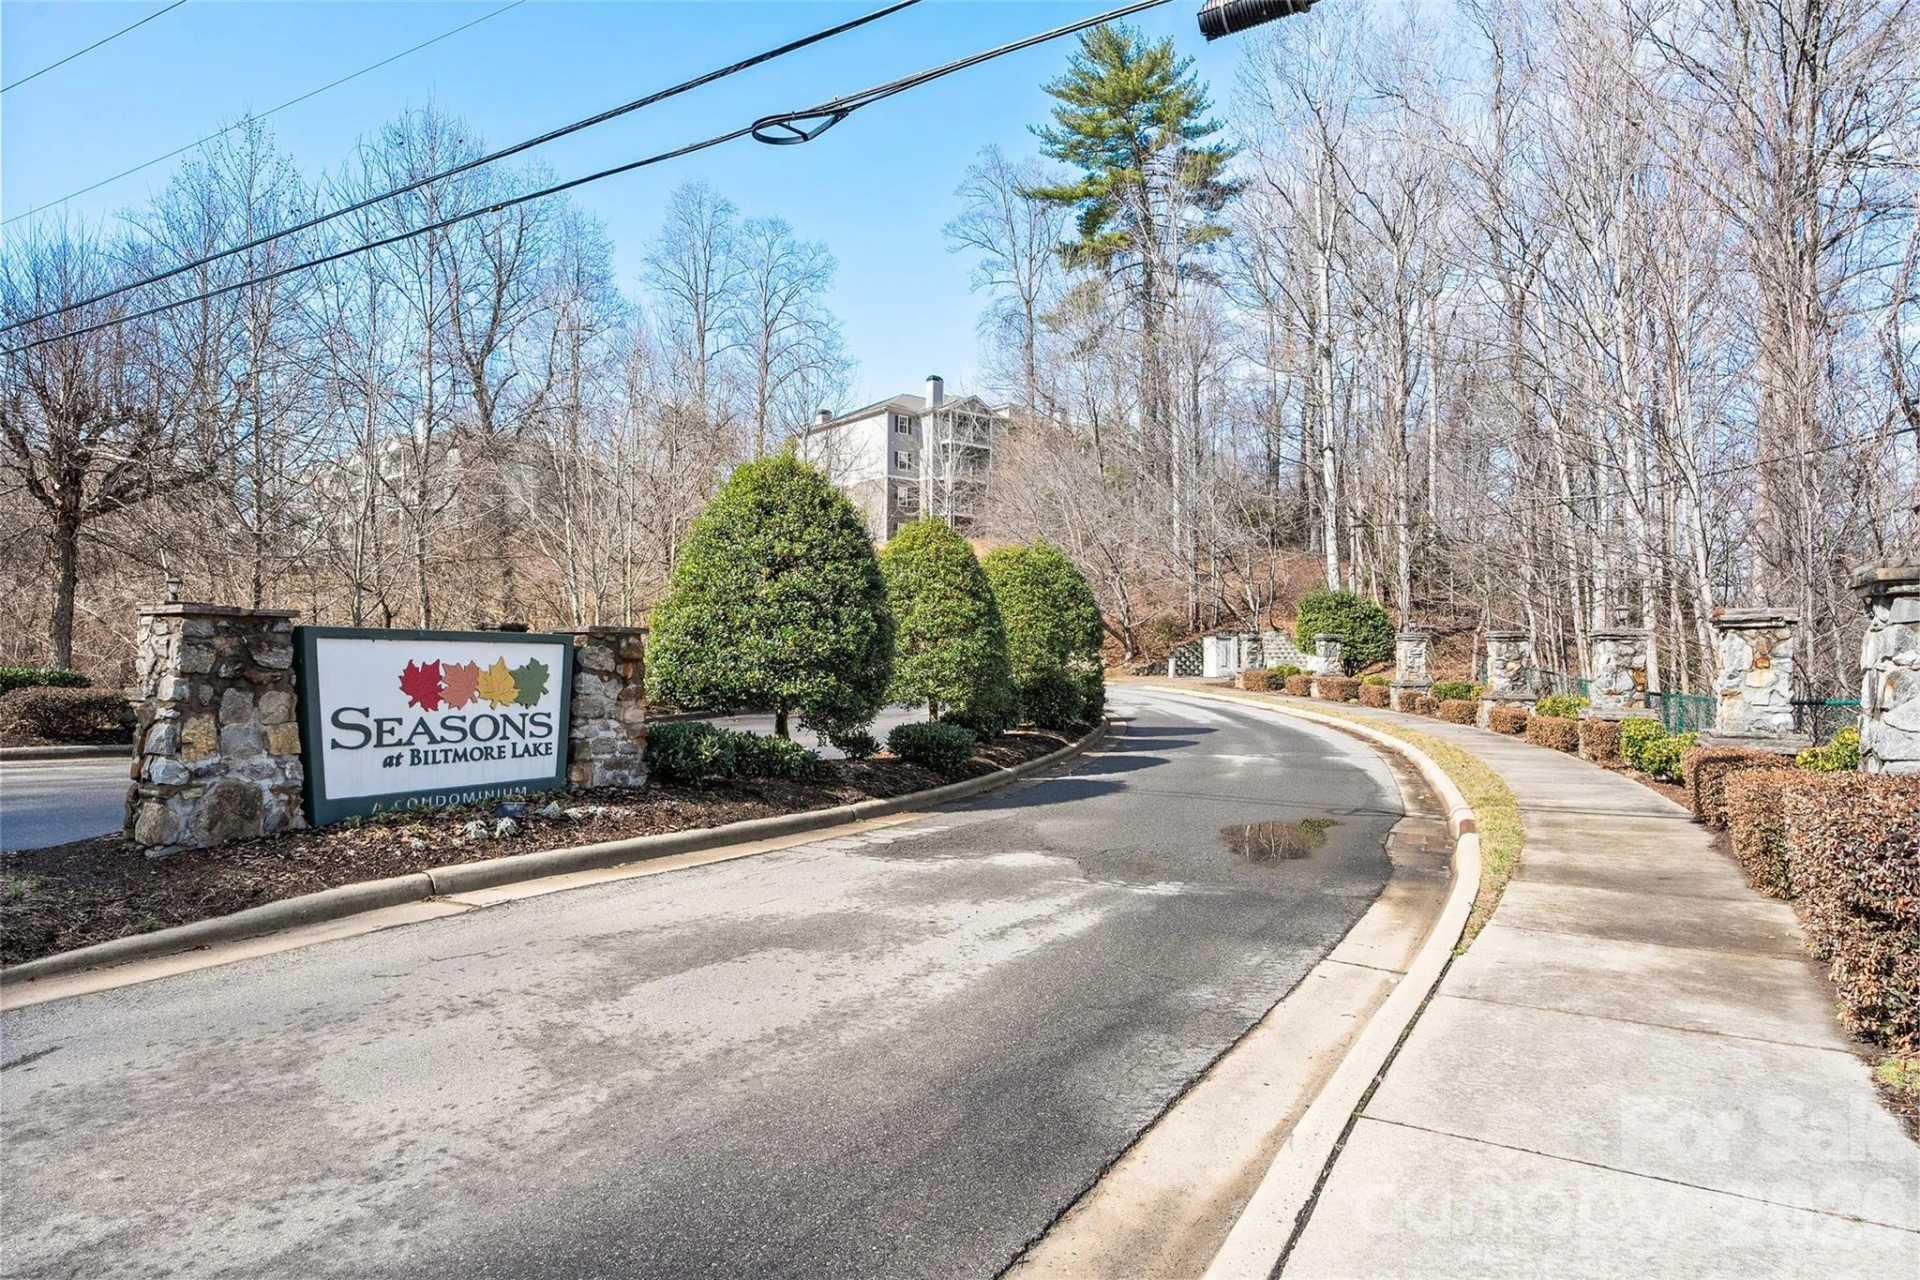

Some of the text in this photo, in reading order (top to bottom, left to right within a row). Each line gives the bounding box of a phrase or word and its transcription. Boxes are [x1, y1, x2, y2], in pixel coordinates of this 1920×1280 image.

[331, 707, 553, 750] SEASONS
[382, 741, 553, 768] at BILTMORE LAKE
